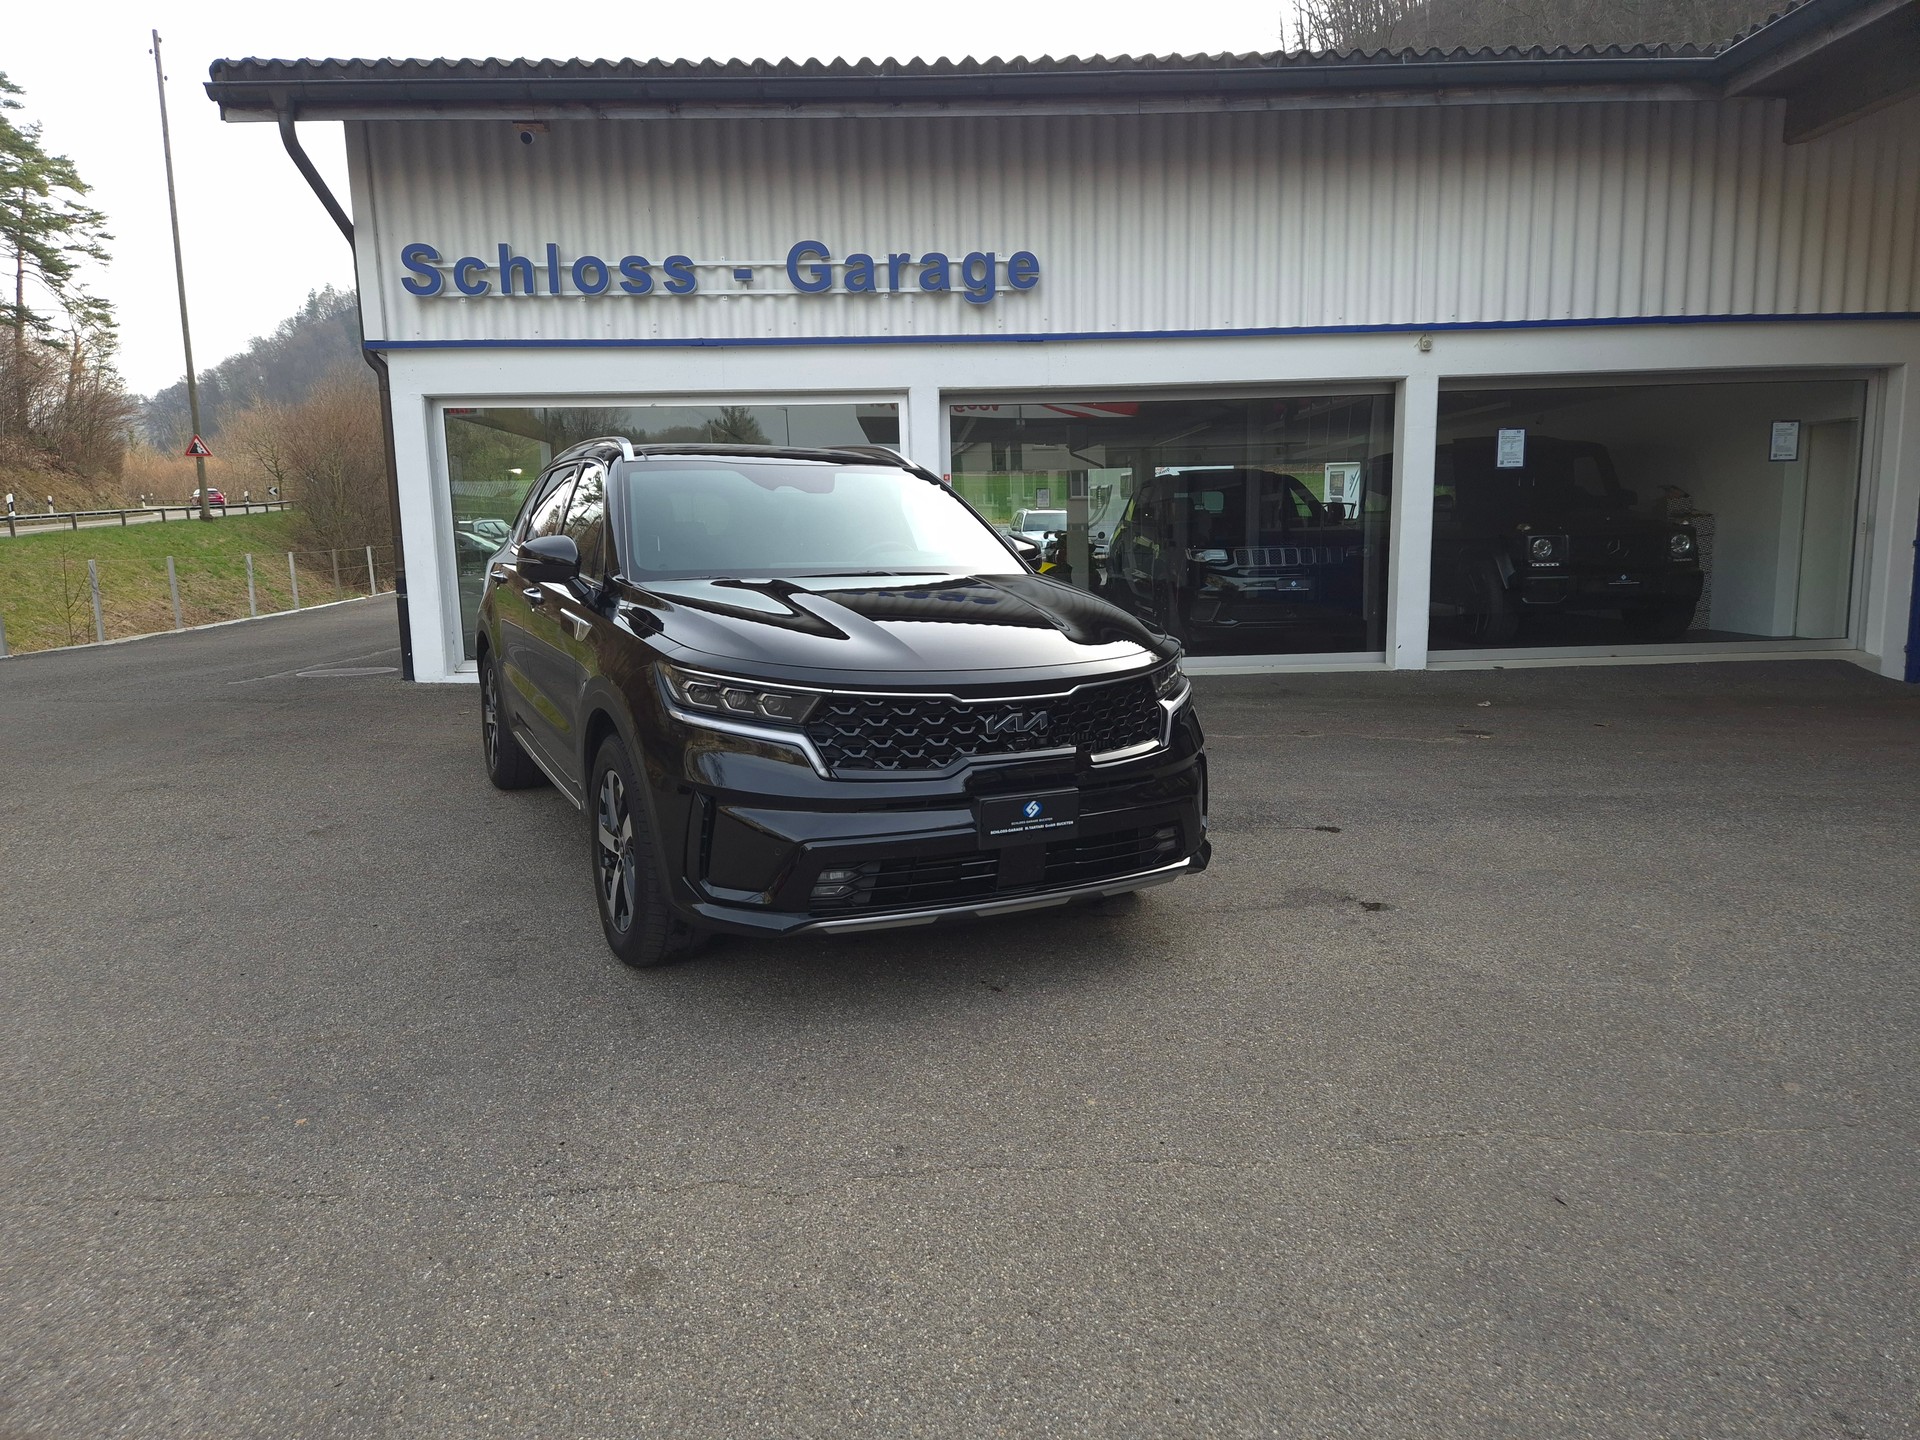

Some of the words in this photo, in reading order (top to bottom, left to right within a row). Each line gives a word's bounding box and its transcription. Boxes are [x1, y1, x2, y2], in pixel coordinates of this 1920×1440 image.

[400, 242, 698, 298] Schloss
[733, 268, 753, 282] -
[786, 240, 1041, 305] Garage
